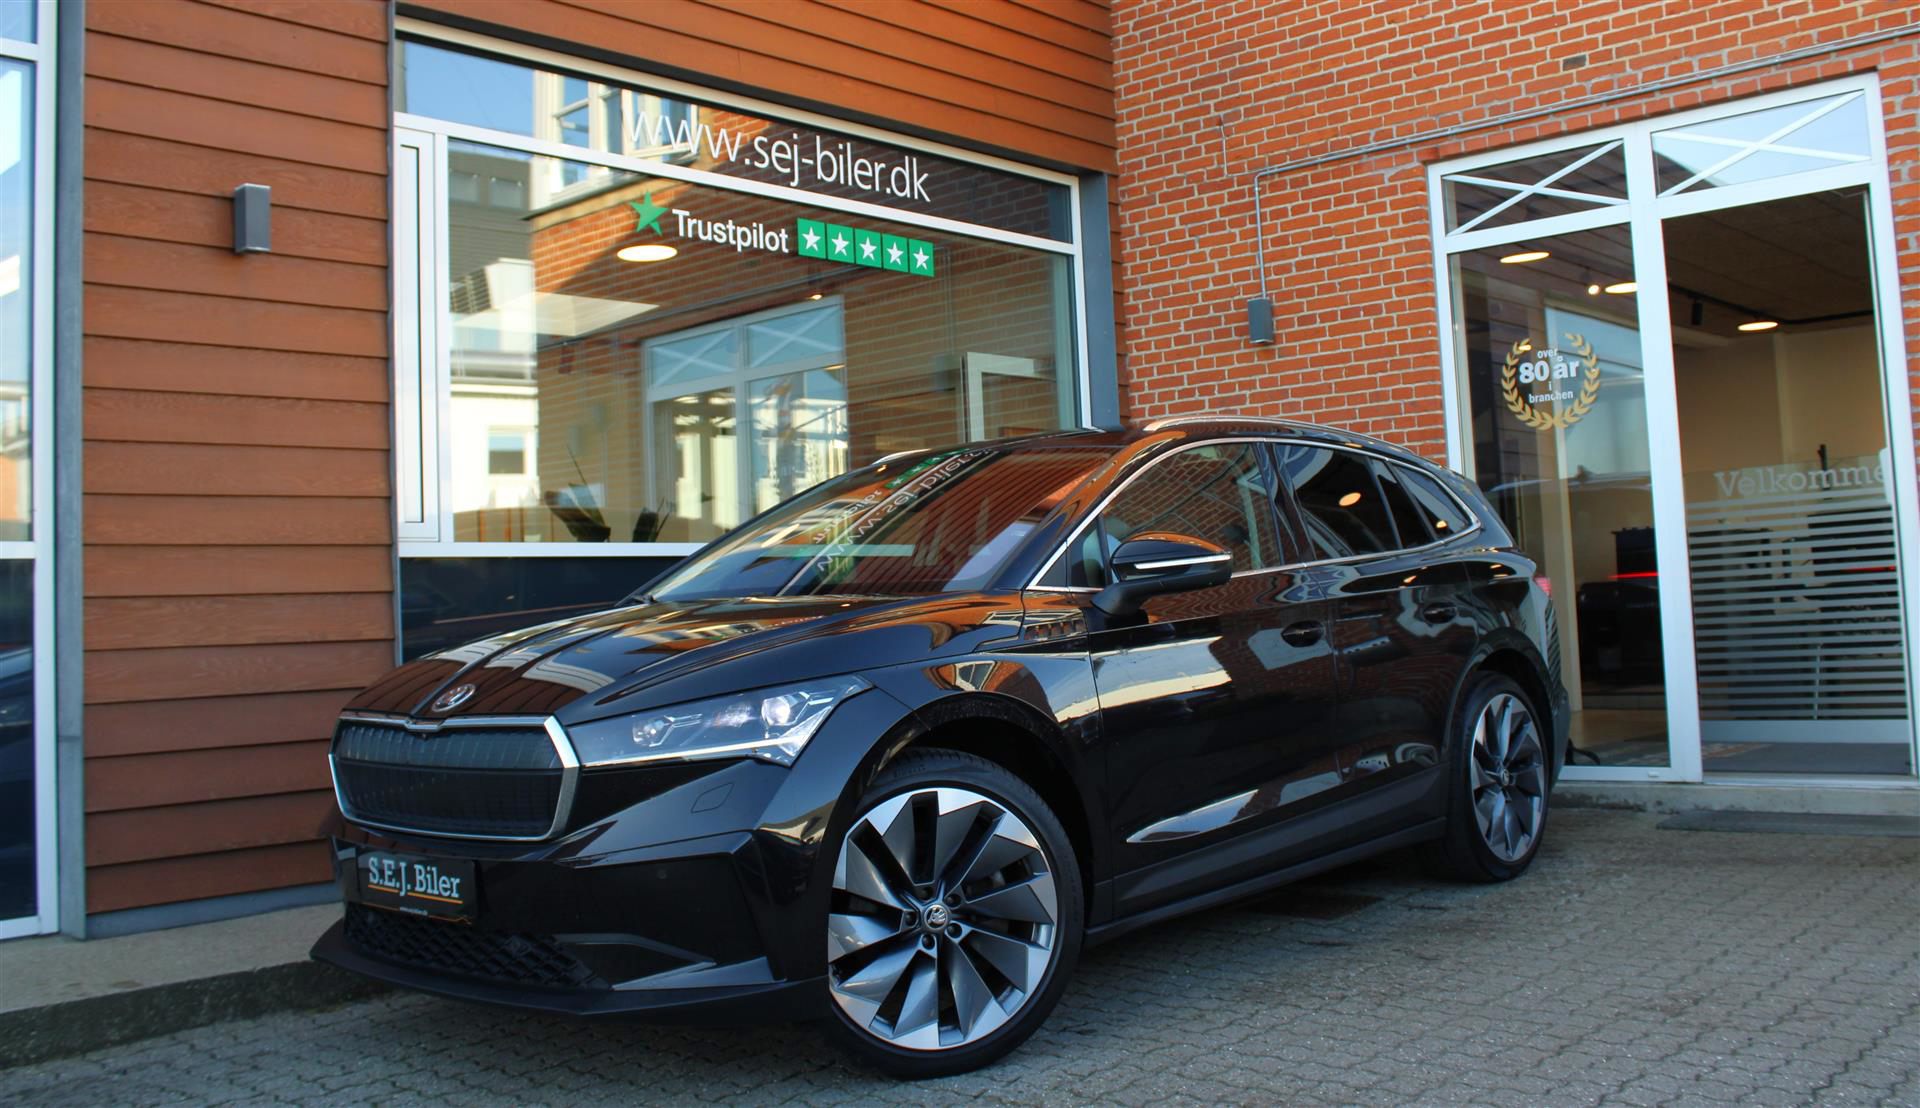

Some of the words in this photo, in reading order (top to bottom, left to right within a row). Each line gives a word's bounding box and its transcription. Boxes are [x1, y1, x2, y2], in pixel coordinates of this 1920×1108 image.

[624, 105, 931, 203] www.sej-biler.dk
[671, 208, 789, 254] Trustpilot
[1537, 348, 1558, 359] over
[1519, 360, 1550, 384] 80
[1552, 356, 1580, 380] år
[1528, 390, 1574, 404] branchen
[1548, 381, 1553, 391] i
[1714, 465, 1883, 497] Velkomme
[368, 857, 411, 897] S.E.J.
[414, 864, 461, 898] Biler
